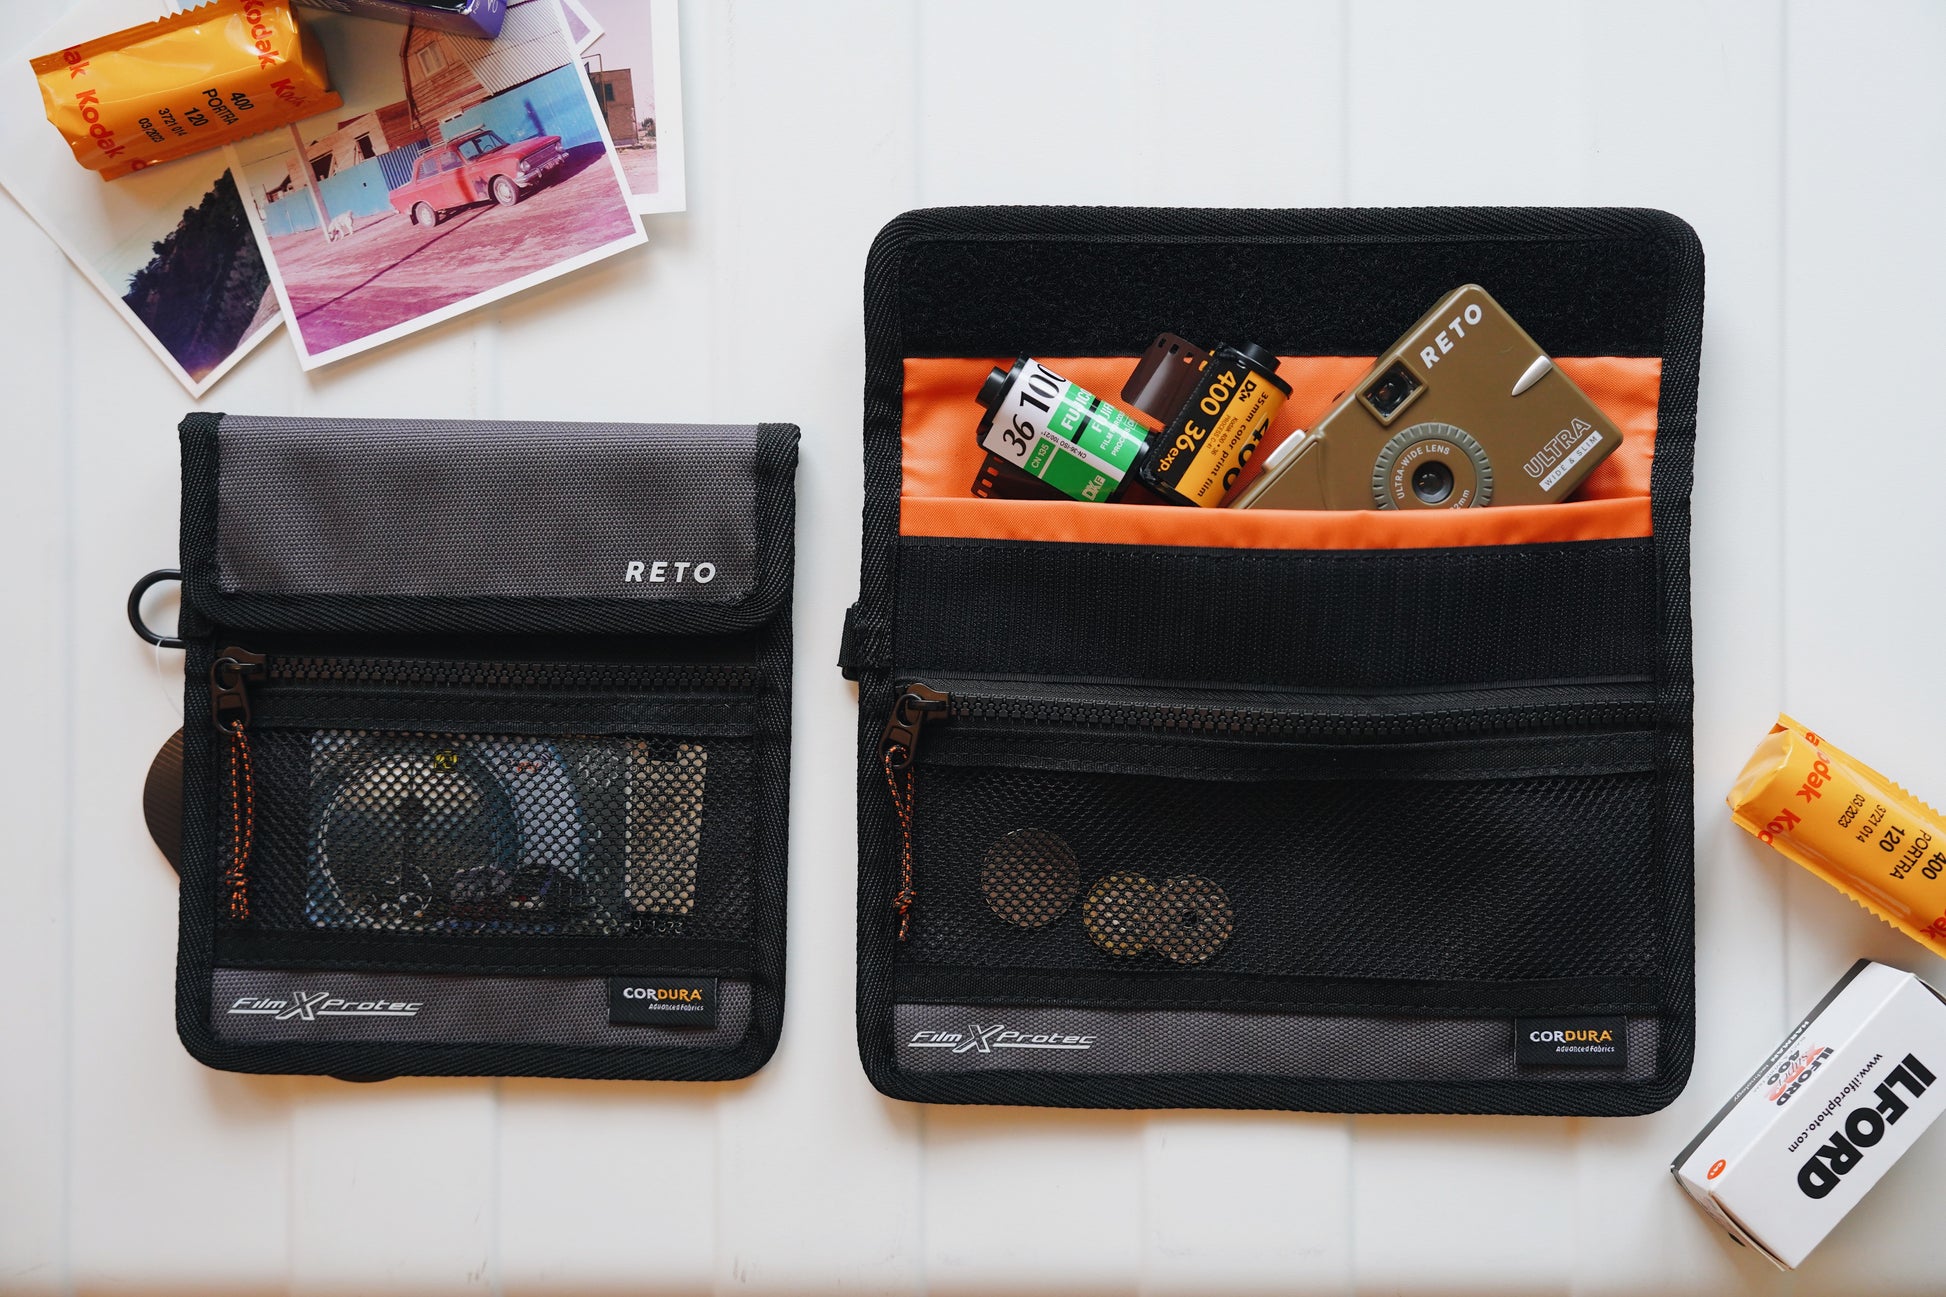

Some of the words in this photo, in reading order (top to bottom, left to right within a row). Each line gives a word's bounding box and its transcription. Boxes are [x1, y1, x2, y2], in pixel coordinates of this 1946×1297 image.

[202, 88, 239, 125] PORTRA
[230, 92, 254, 111] 400
[75, 88, 127, 159] Kodak
[138, 117, 165, 143] 03/2023
[184, 107, 209, 127] 120
[1419, 303, 1482, 369] RETO
[1200, 370, 1237, 416] 400
[1246, 391, 1269, 422] 35mm
[1002, 413, 1035, 457] 36
[1229, 424, 1247, 450] color
[1523, 418, 1591, 478] ULTRA
[1425, 444, 1450, 455] LENS
[1544, 464, 1567, 486] WIDE
[1576, 436, 1598, 457] SLIM
[1211, 450, 1229, 477] print
[1197, 478, 1213, 497] film
[625, 561, 716, 584] RETO
[1838, 794, 1866, 828] 03/2023
[1870, 804, 1887, 826] 3721
[1856, 825, 1874, 843] 014
[1880, 825, 1906, 852] 120
[1889, 830, 1932, 880] PORTRA
[1922, 852, 1946, 880] 400
[232, 997, 288, 1009] Film
[320, 999, 424, 1011] Protec
[623, 987, 702, 1001] CORDURA
[911, 1031, 963, 1043] Film
[996, 1031, 1097, 1044] Protec
[1529, 1030, 1613, 1043] CORDURA
[1590, 1045, 1615, 1053] Fabrics
[1767, 1050, 1800, 1085] 400
[1776, 1047, 1834, 1106] ILFORD
[1788, 1053, 1883, 1153] www.ilfordphoto.com
[1797, 1052, 1937, 1200] ILFORD
